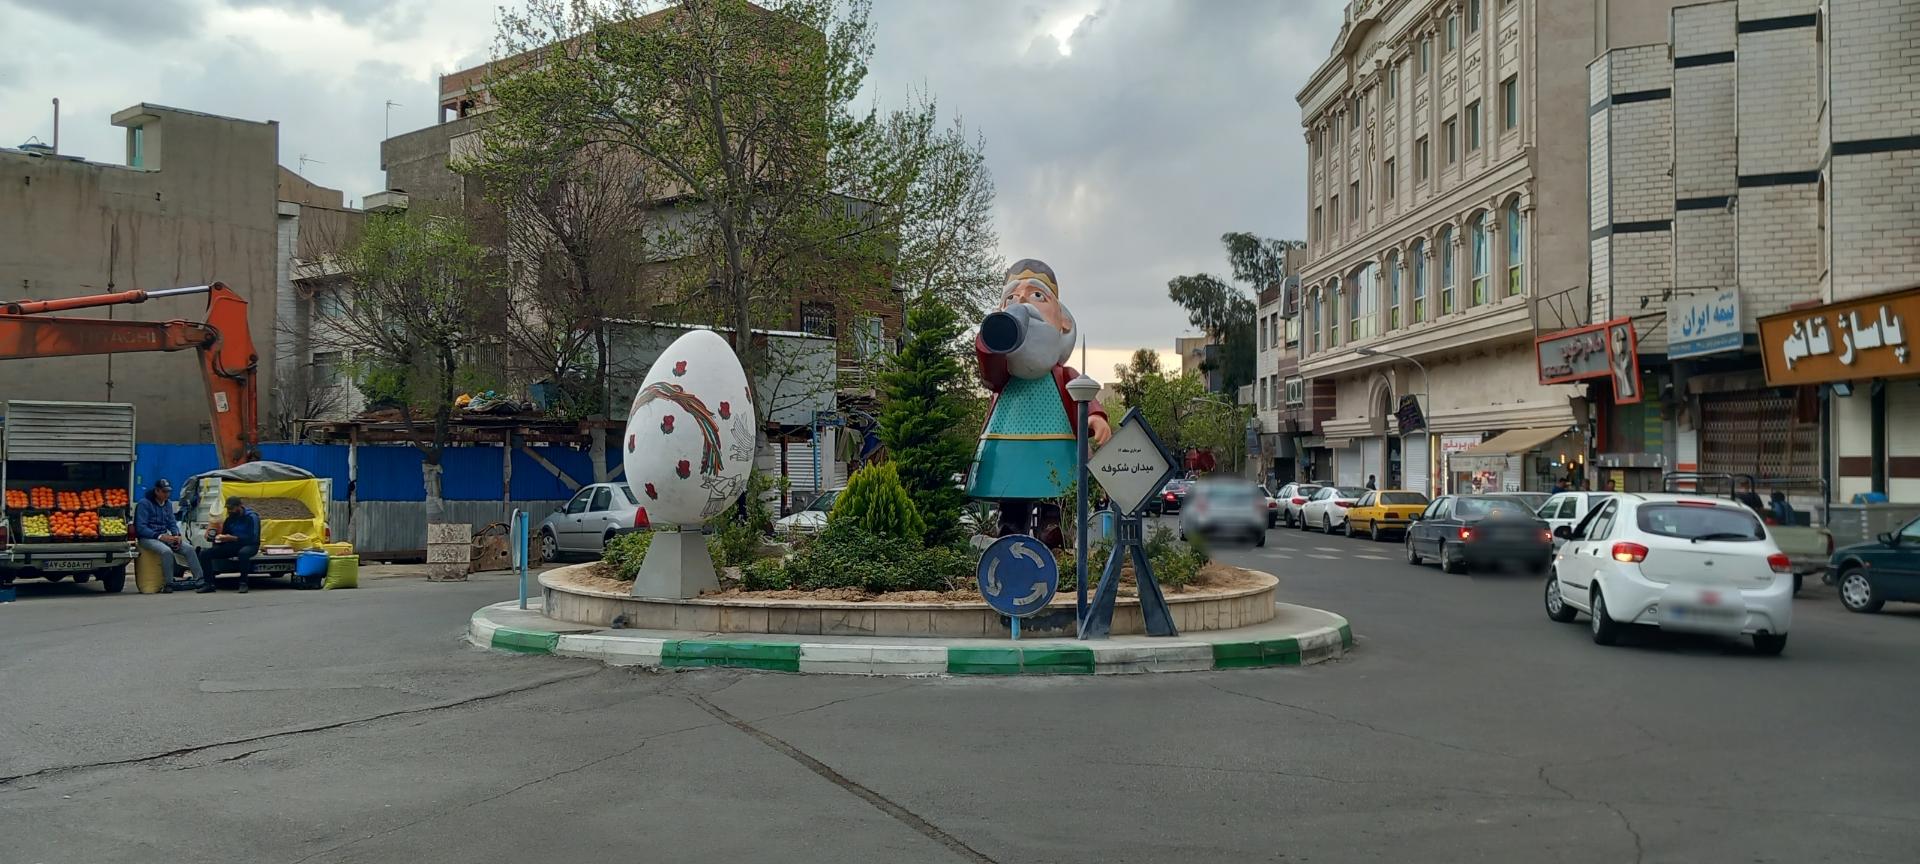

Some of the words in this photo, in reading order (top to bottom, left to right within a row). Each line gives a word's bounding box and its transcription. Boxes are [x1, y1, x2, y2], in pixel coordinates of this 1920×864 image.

[1683, 304, 1710, 337] ایران
[1714, 304, 1734, 328] بیمه
[1783, 316, 1831, 371] قائم
[1838, 304, 1906, 365] پاساژ
[1101, 463, 1129, 476] شکوفه
[1131, 463, 1154, 473] میدان
